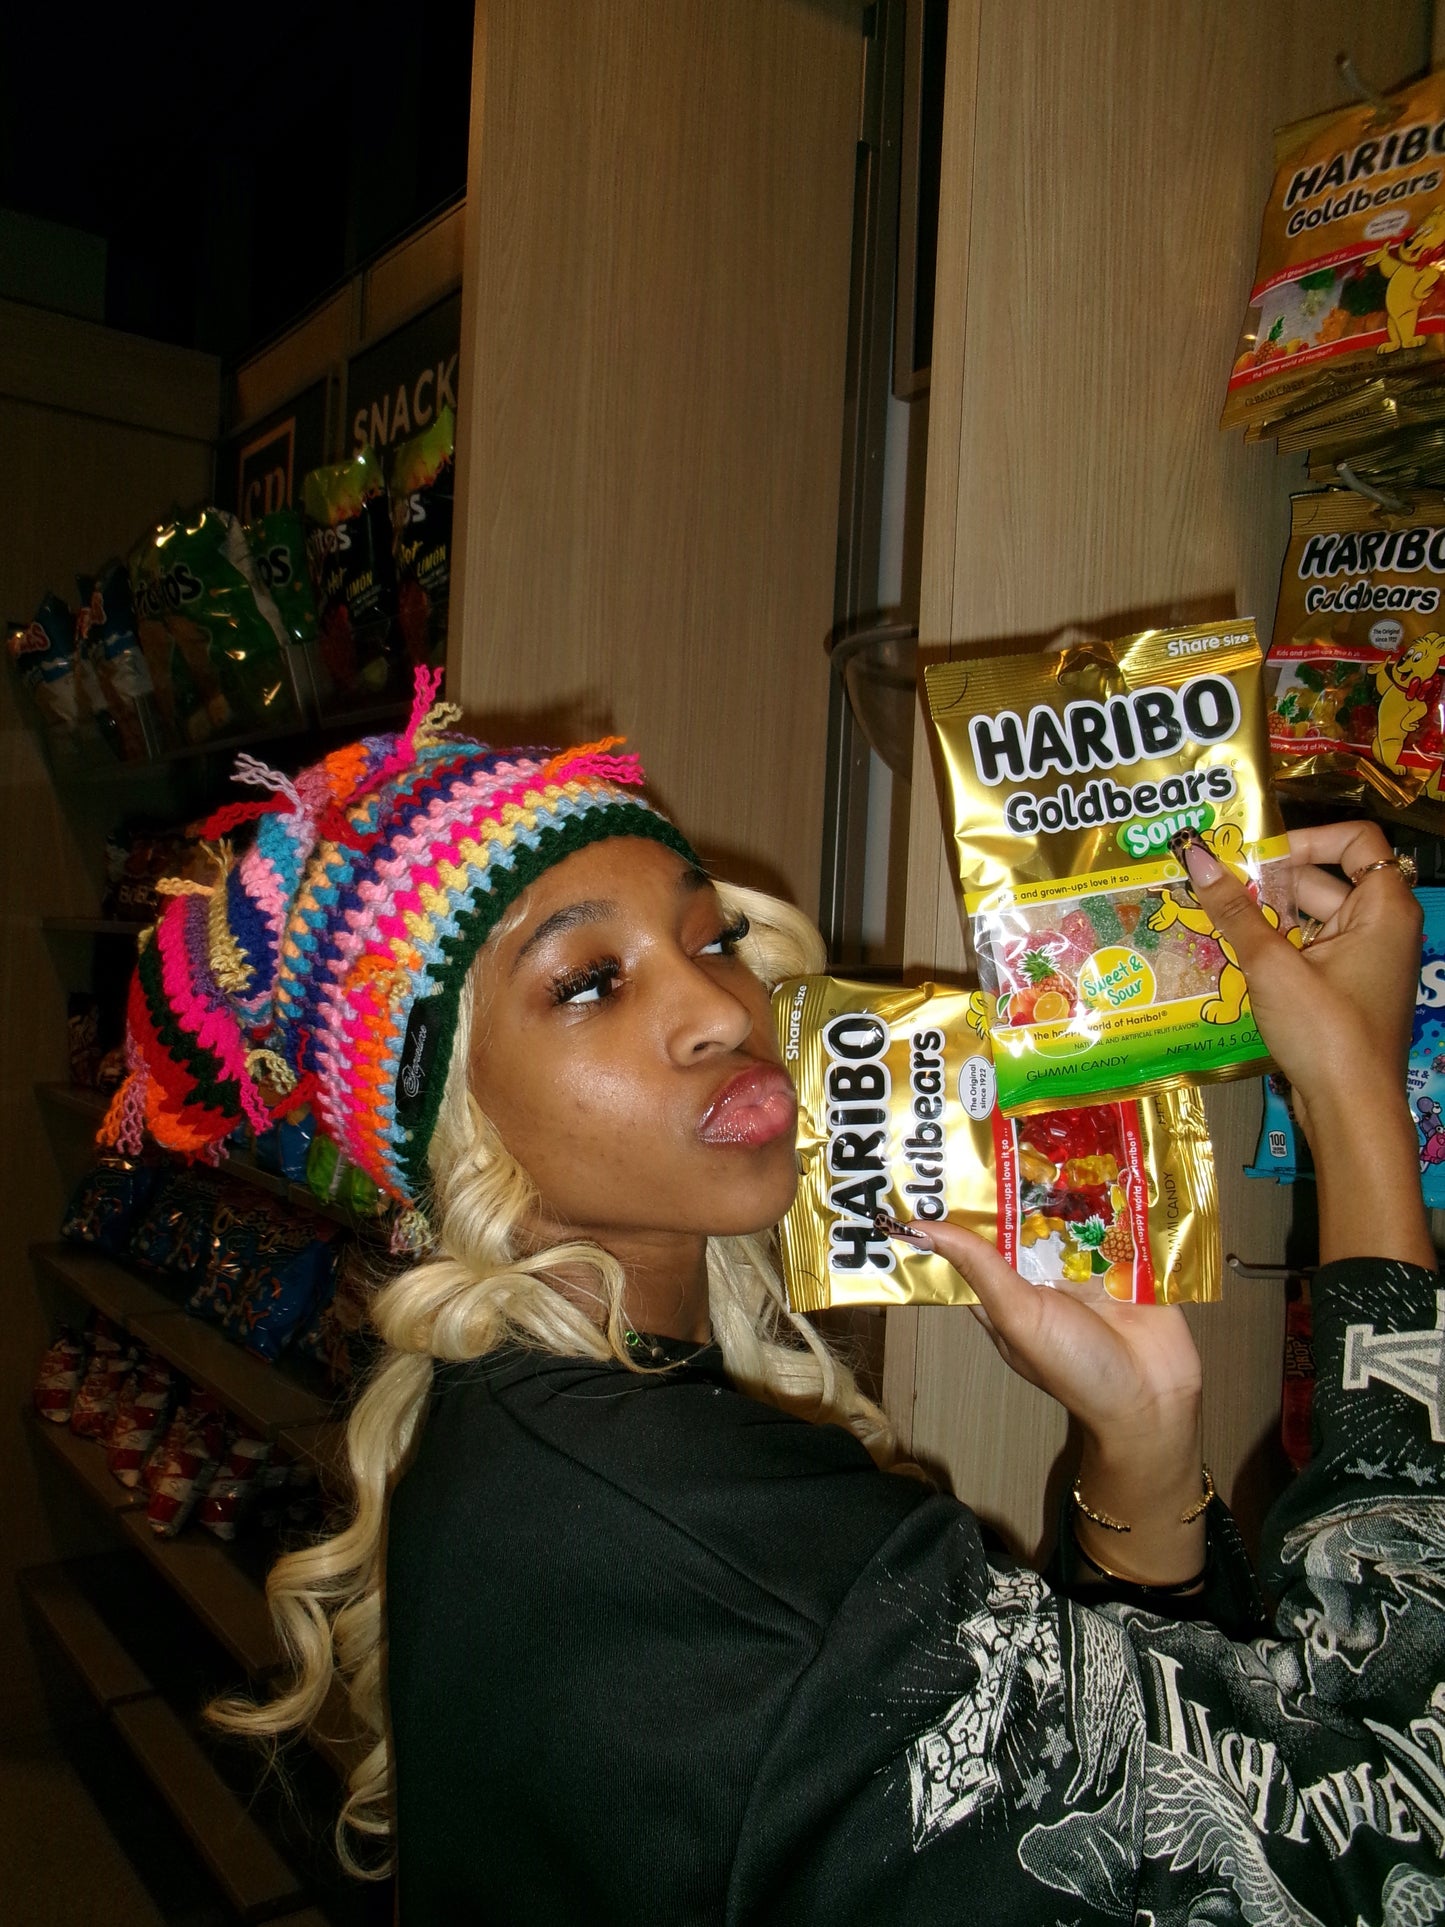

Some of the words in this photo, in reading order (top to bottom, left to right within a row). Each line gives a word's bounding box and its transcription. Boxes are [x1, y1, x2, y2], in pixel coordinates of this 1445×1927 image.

[1286, 168, 1443, 238] Goldbears
[1167, 634, 1220, 657] Share
[1223, 632, 1250, 647] Size
[969, 674, 1241, 786] HARIBO
[1004, 764, 1237, 837] Goldbears
[1127, 808, 1205, 855] Sour
[1020, 888, 1038, 900] and
[1040, 881, 1088, 898] grown-ups
[1090, 876, 1109, 888] love
[1111, 875, 1117, 884] it
[1119, 874, 1130, 883] so
[1084, 961, 1130, 997] Sweet
[1129, 954, 1144, 972] &
[1107, 978, 1142, 1007] Sour
[785, 1009, 801, 1061] Share
[795, 984, 807, 1006] Size
[1034, 1031, 1050, 1041] the
[1114, 1018, 1124, 1028] of
[1105, 1036, 1120, 1045] AND
[1121, 1031, 1153, 1042] ARTIFICIAL
[1154, 1027, 1171, 1036] FRUIT
[1172, 1022, 1199, 1033] FLAVORS
[1193, 1039, 1213, 1052] WT
[1217, 1034, 1237, 1048] 4.5
[1241, 1029, 1260, 1043] OZ
[969, 1063, 979, 1097] Original
[980, 1067, 988, 1087] 1922
[1026, 1063, 1078, 1083] GUMMI
[1081, 1054, 1130, 1073] CANDY
[1421, 1070, 1430, 1080] &
[970, 1098, 978, 1113] The
[980, 1088, 988, 1110] since
[824, 1012, 896, 1274] HARIBO
[902, 1027, 948, 1255] oldbears
[1002, 1138, 1009, 1151] so
[1270, 1133, 1286, 1147] 100
[1003, 1151, 1010, 1163] it
[1003, 1164, 1011, 1184] love
[1003, 1186, 1014, 1230] grown-ups
[1133, 1184, 1143, 1212] world
[1163, 1171, 1180, 1219] CANDY
[1004, 1232, 1012, 1252] and
